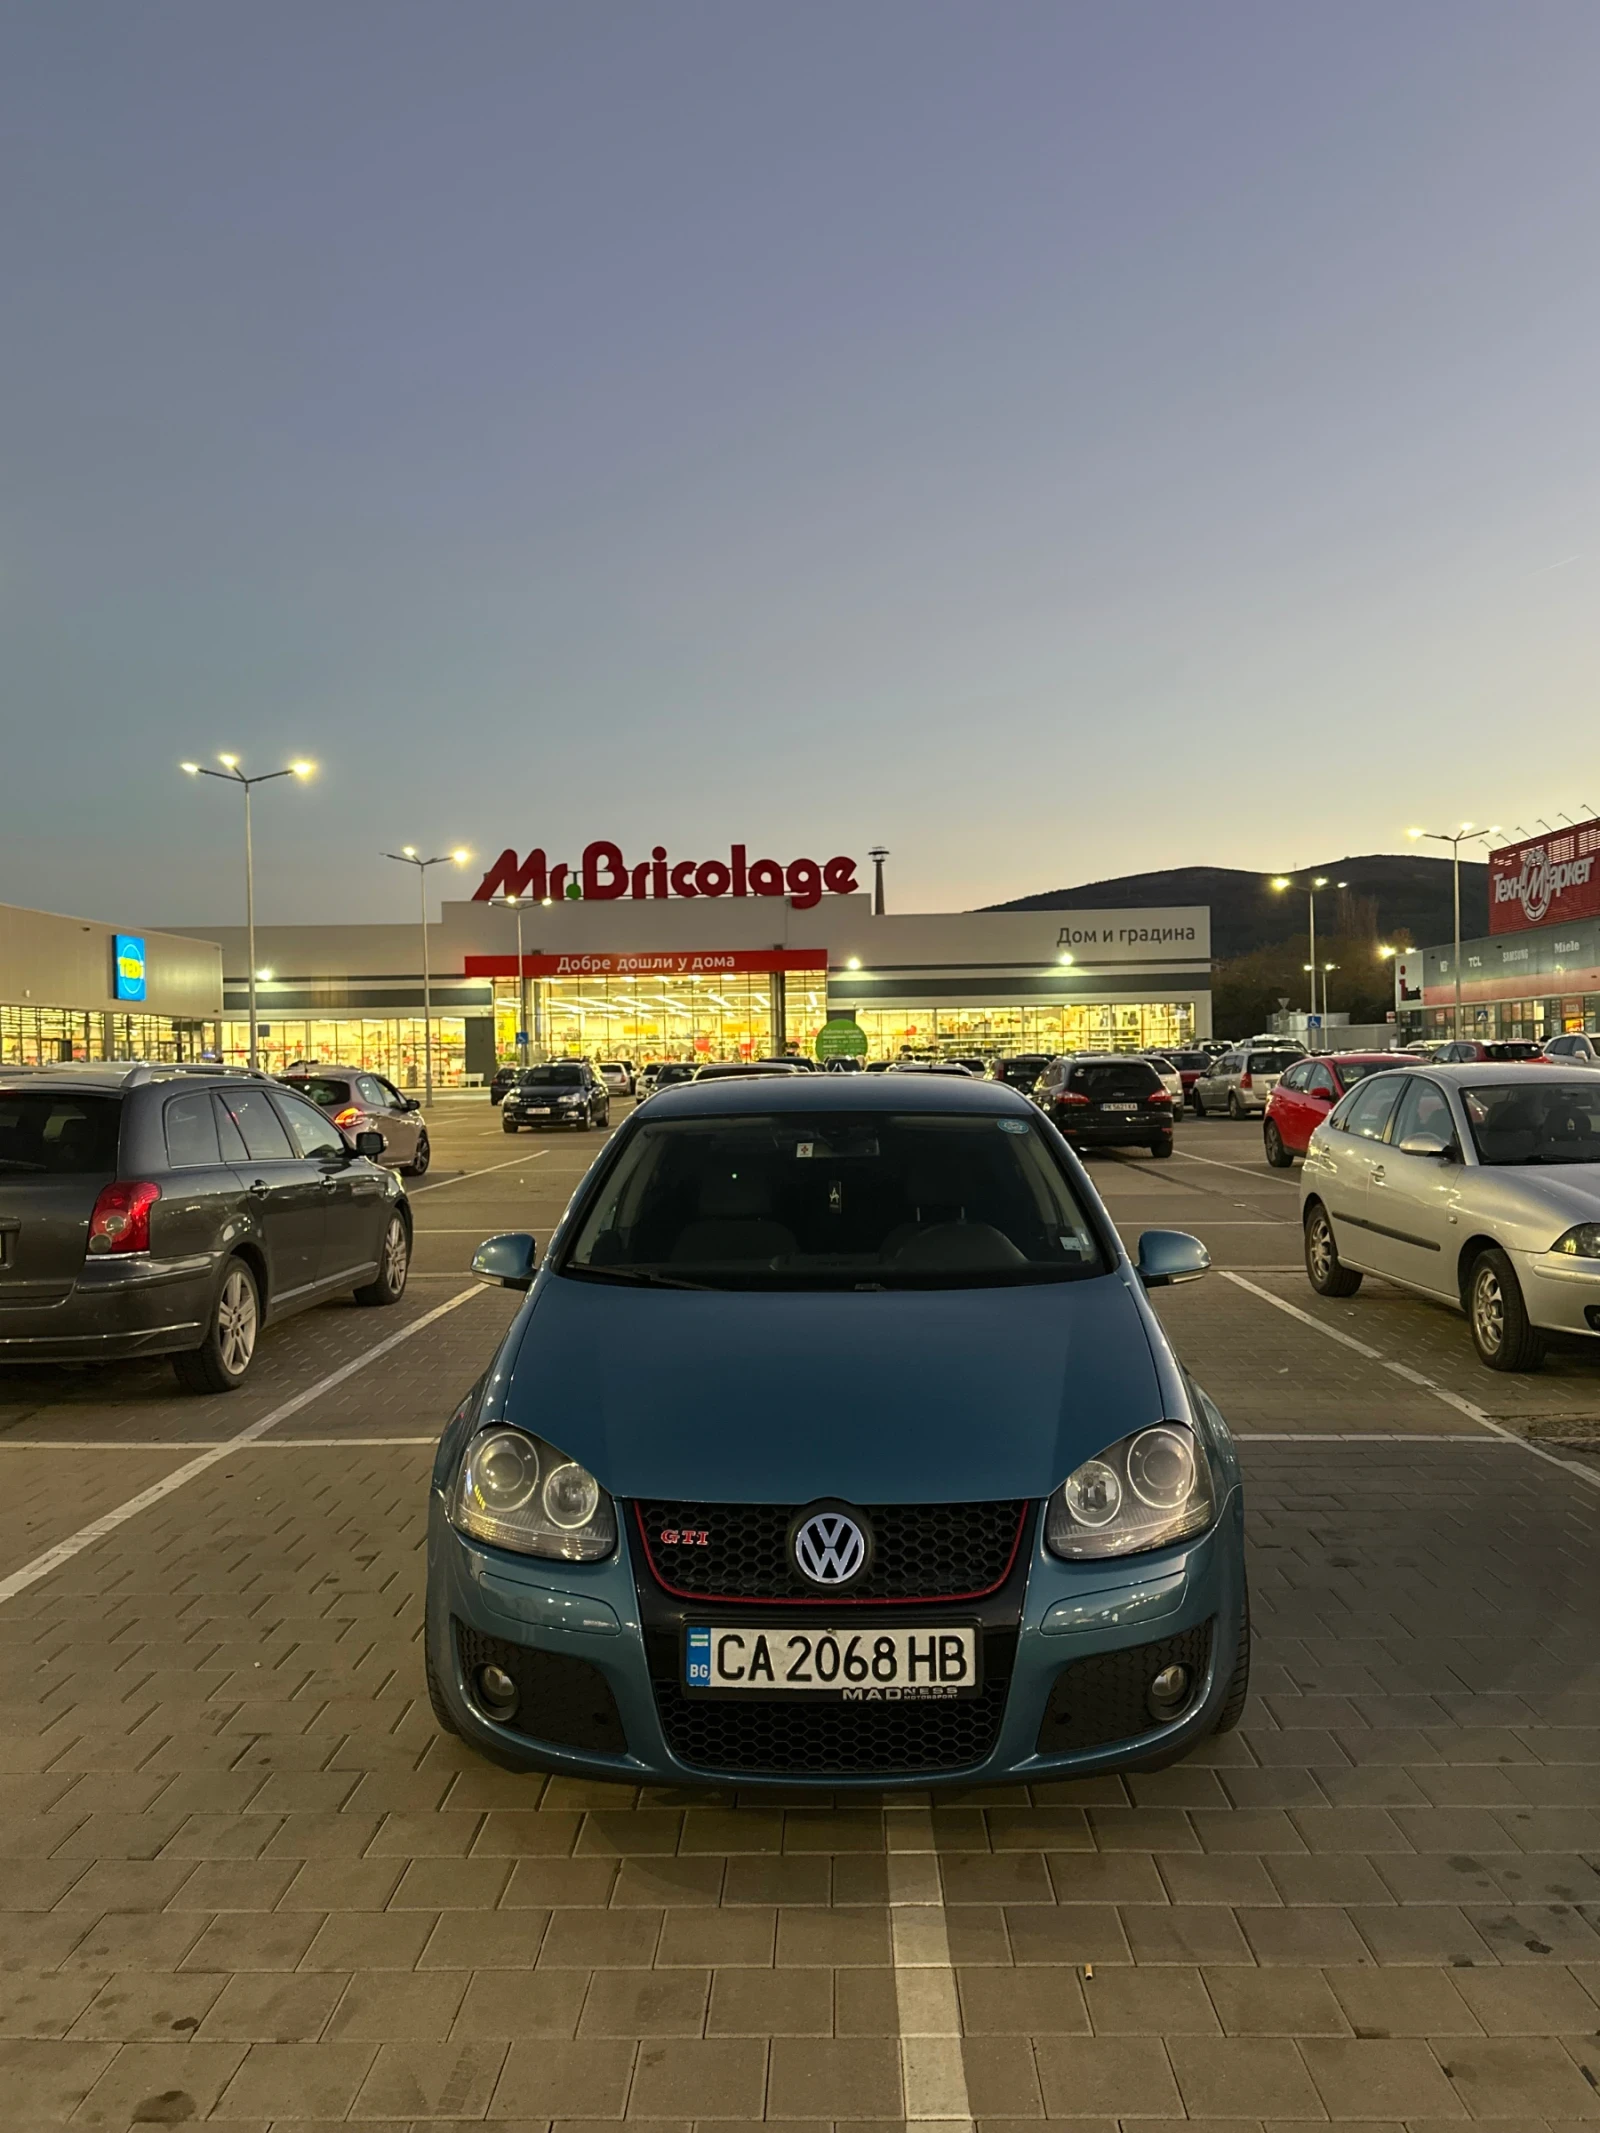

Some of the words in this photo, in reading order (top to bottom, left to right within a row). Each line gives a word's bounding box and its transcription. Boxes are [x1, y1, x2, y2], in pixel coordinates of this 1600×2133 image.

[1056, 927, 1097, 948] Дом
[1103, 929, 1113, 943] и
[1119, 927, 1195, 946] градина
[1554, 940, 1580, 954] Miele
[1468, 956, 1482, 967] TCL
[1502, 948, 1529, 963] SAMSUNG
[557, 956, 611, 973] Добре
[617, 957, 673, 972] дошли
[678, 957, 688, 971] у
[691, 955, 735, 970] дома
[660, 1529, 709, 1546] GTI
[690, 1663, 709, 1678] BG
